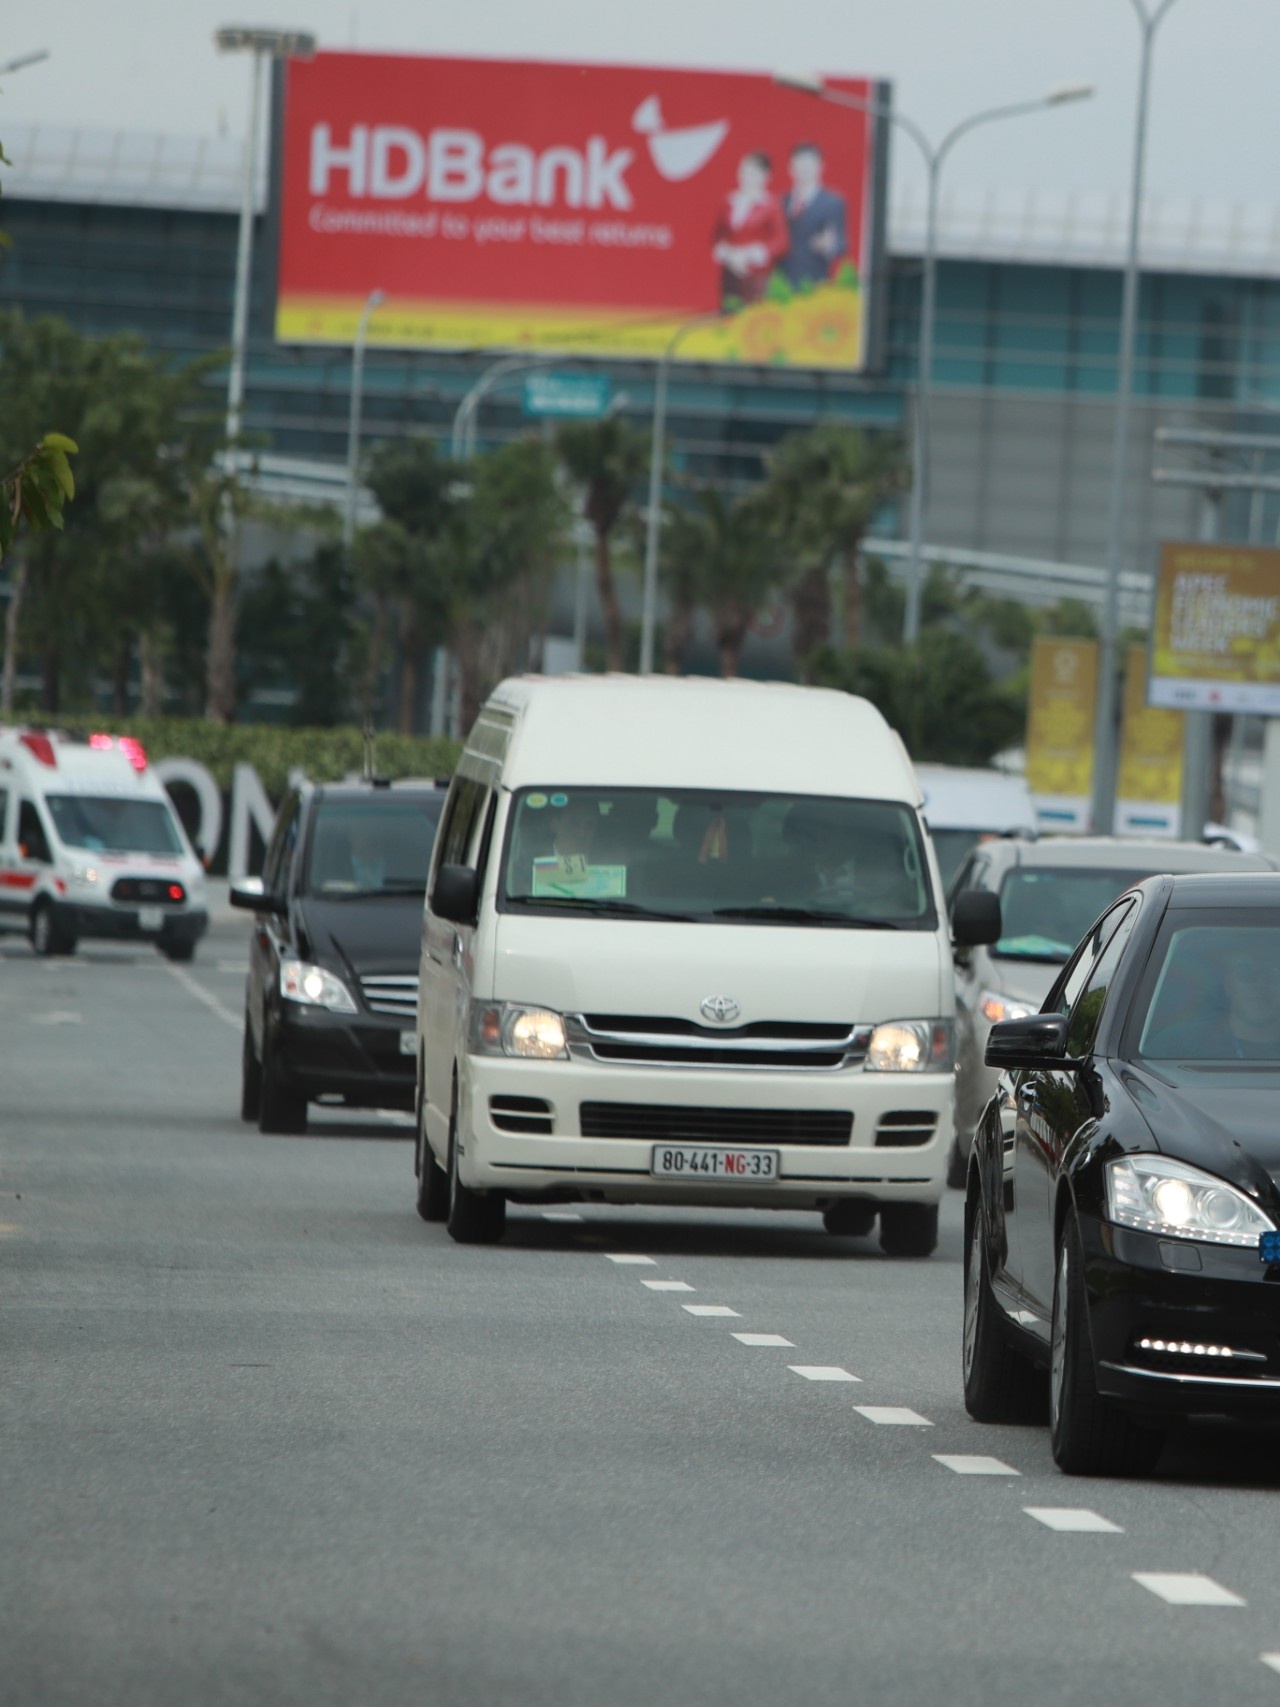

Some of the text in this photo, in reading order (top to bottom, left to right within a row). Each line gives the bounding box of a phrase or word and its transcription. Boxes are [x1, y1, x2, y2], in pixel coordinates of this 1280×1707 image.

[308, 121, 636, 212] HDBank
[308, 203, 672, 250] Committed to your best returns
